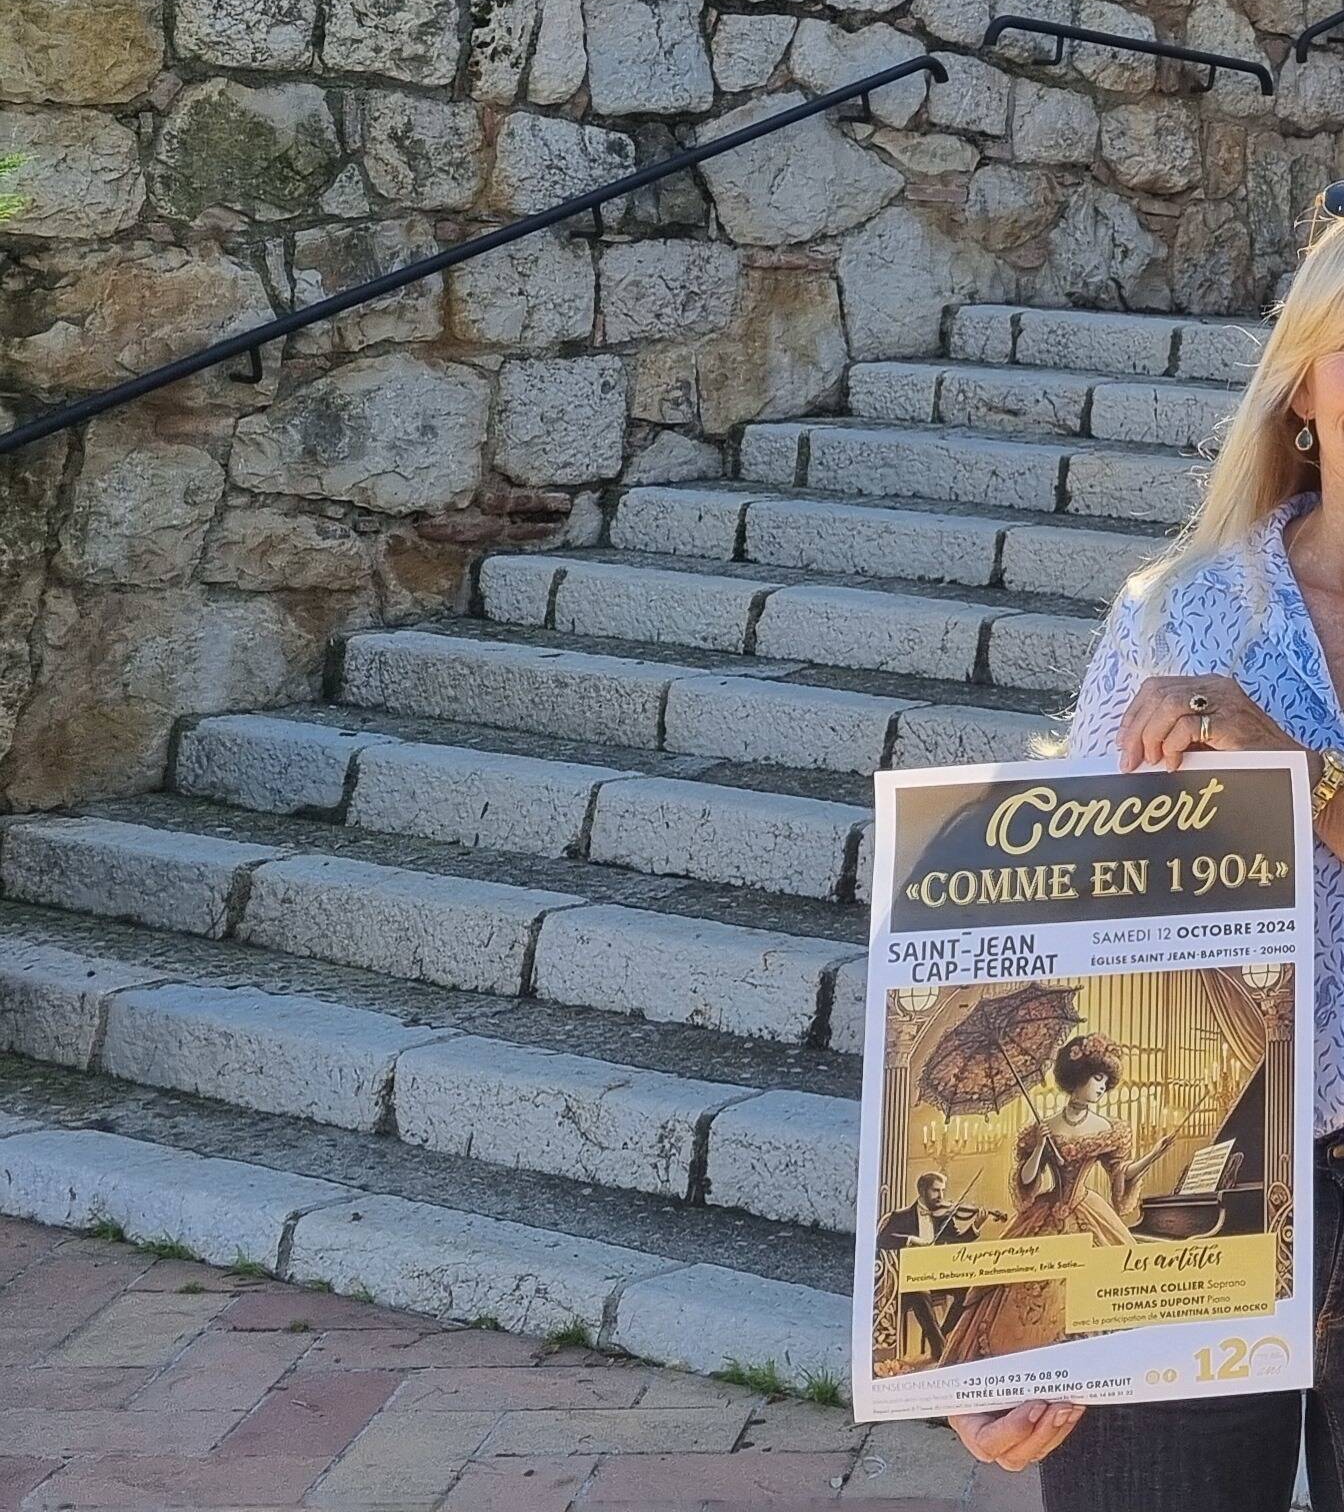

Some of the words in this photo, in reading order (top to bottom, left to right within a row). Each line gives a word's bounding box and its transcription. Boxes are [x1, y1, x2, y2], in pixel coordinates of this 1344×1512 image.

[986, 777, 1224, 855] Concert
[906, 864, 1080, 909] «COMME
[1091, 859, 1150, 897] EN
[1166, 853, 1290, 897] 1904»
[1092, 928, 1150, 945] SAMEDI
[1157, 927, 1171, 941] 12
[1176, 922, 1251, 939] OCTOBRE
[1256, 920, 1295, 934] 2024
[888, 934, 1035, 963] SAINT-JEAN
[1090, 952, 1128, 966] ÉGLISE
[1130, 951, 1164, 964] SAINT
[1166, 947, 1250, 962] JEAN-BAPTISTE
[1260, 944, 1296, 955] 20H00
[912, 954, 1058, 983] CAP-FERRAT
[1122, 1249, 1150, 1273] Les
[1154, 1246, 1223, 1271] artistes
[906, 1273, 937, 1282] Puccini,
[939, 1271, 976, 1280] Debussy,
[1040, 1262, 1054, 1270] Erik
[1096, 1285, 1157, 1298] CHRISTINA
[1160, 1281, 1204, 1292] COLLIER
[1207, 1279, 1246, 1290] Soprano
[1112, 1299, 1157, 1312] THOMAS
[1160, 1296, 1205, 1307] DUPONT
[1207, 1295, 1230, 1304] Piano
[1072, 1319, 1090, 1327] avec
[1092, 1317, 1099, 1325] la
[1101, 1314, 1146, 1326] participation
[1148, 1312, 1157, 1320] de
[1159, 1308, 1210, 1319] VALENTINA
[1212, 1306, 1231, 1315] SILO
[956, 1389, 994, 1400] ENTRÉE
[996, 1387, 1025, 1397] LIBRE
[1033, 1382, 1083, 1394] PARKING
[1086, 1377, 1131, 1390] GRATUIT
[984, 1376, 1006, 1387] (0)4
[1008, 1374, 1021, 1383] 93
[1024, 1373, 1036, 1382] 76
[1039, 1372, 1052, 1381] 08
[1055, 1370, 1069, 1379] 90
